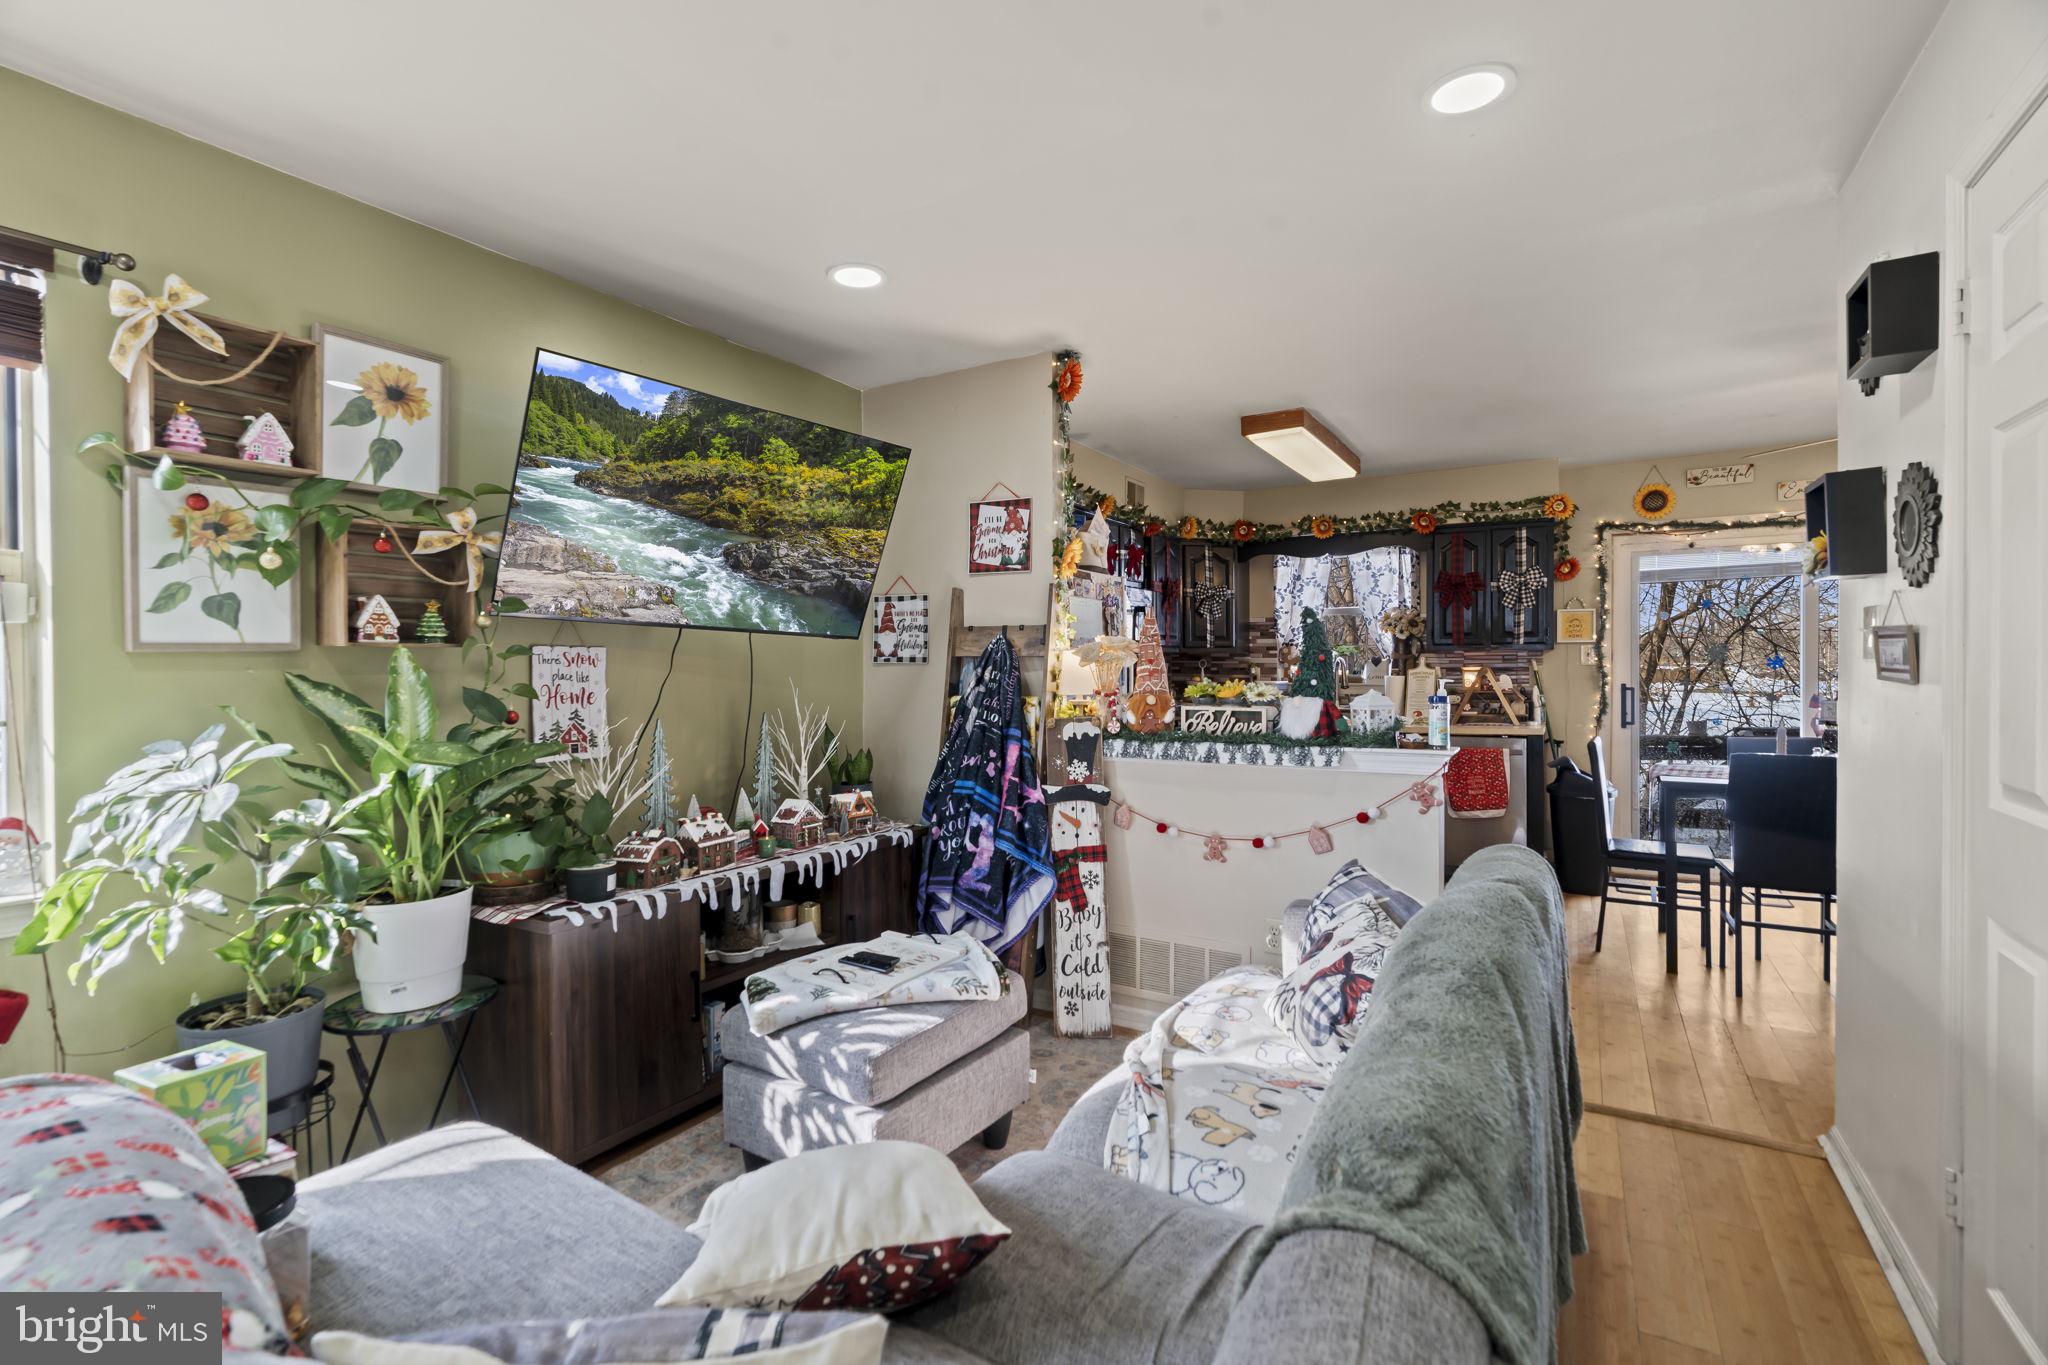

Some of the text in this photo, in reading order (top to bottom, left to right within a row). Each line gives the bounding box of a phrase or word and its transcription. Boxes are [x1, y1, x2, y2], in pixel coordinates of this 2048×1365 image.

[1699, 464, 1752, 485] Beautiful
[972, 543, 1015, 561] Christmas
[537, 651, 600, 668] There's Snow
[552, 669, 590, 686] place like
[540, 683, 597, 710] Home
[1186, 708, 1263, 736] Believe
[1057, 905, 1102, 932] Baby
[1070, 933, 1092, 951] it's
[1061, 952, 1104, 976] Cold
[1059, 982, 1108, 1001] outside
